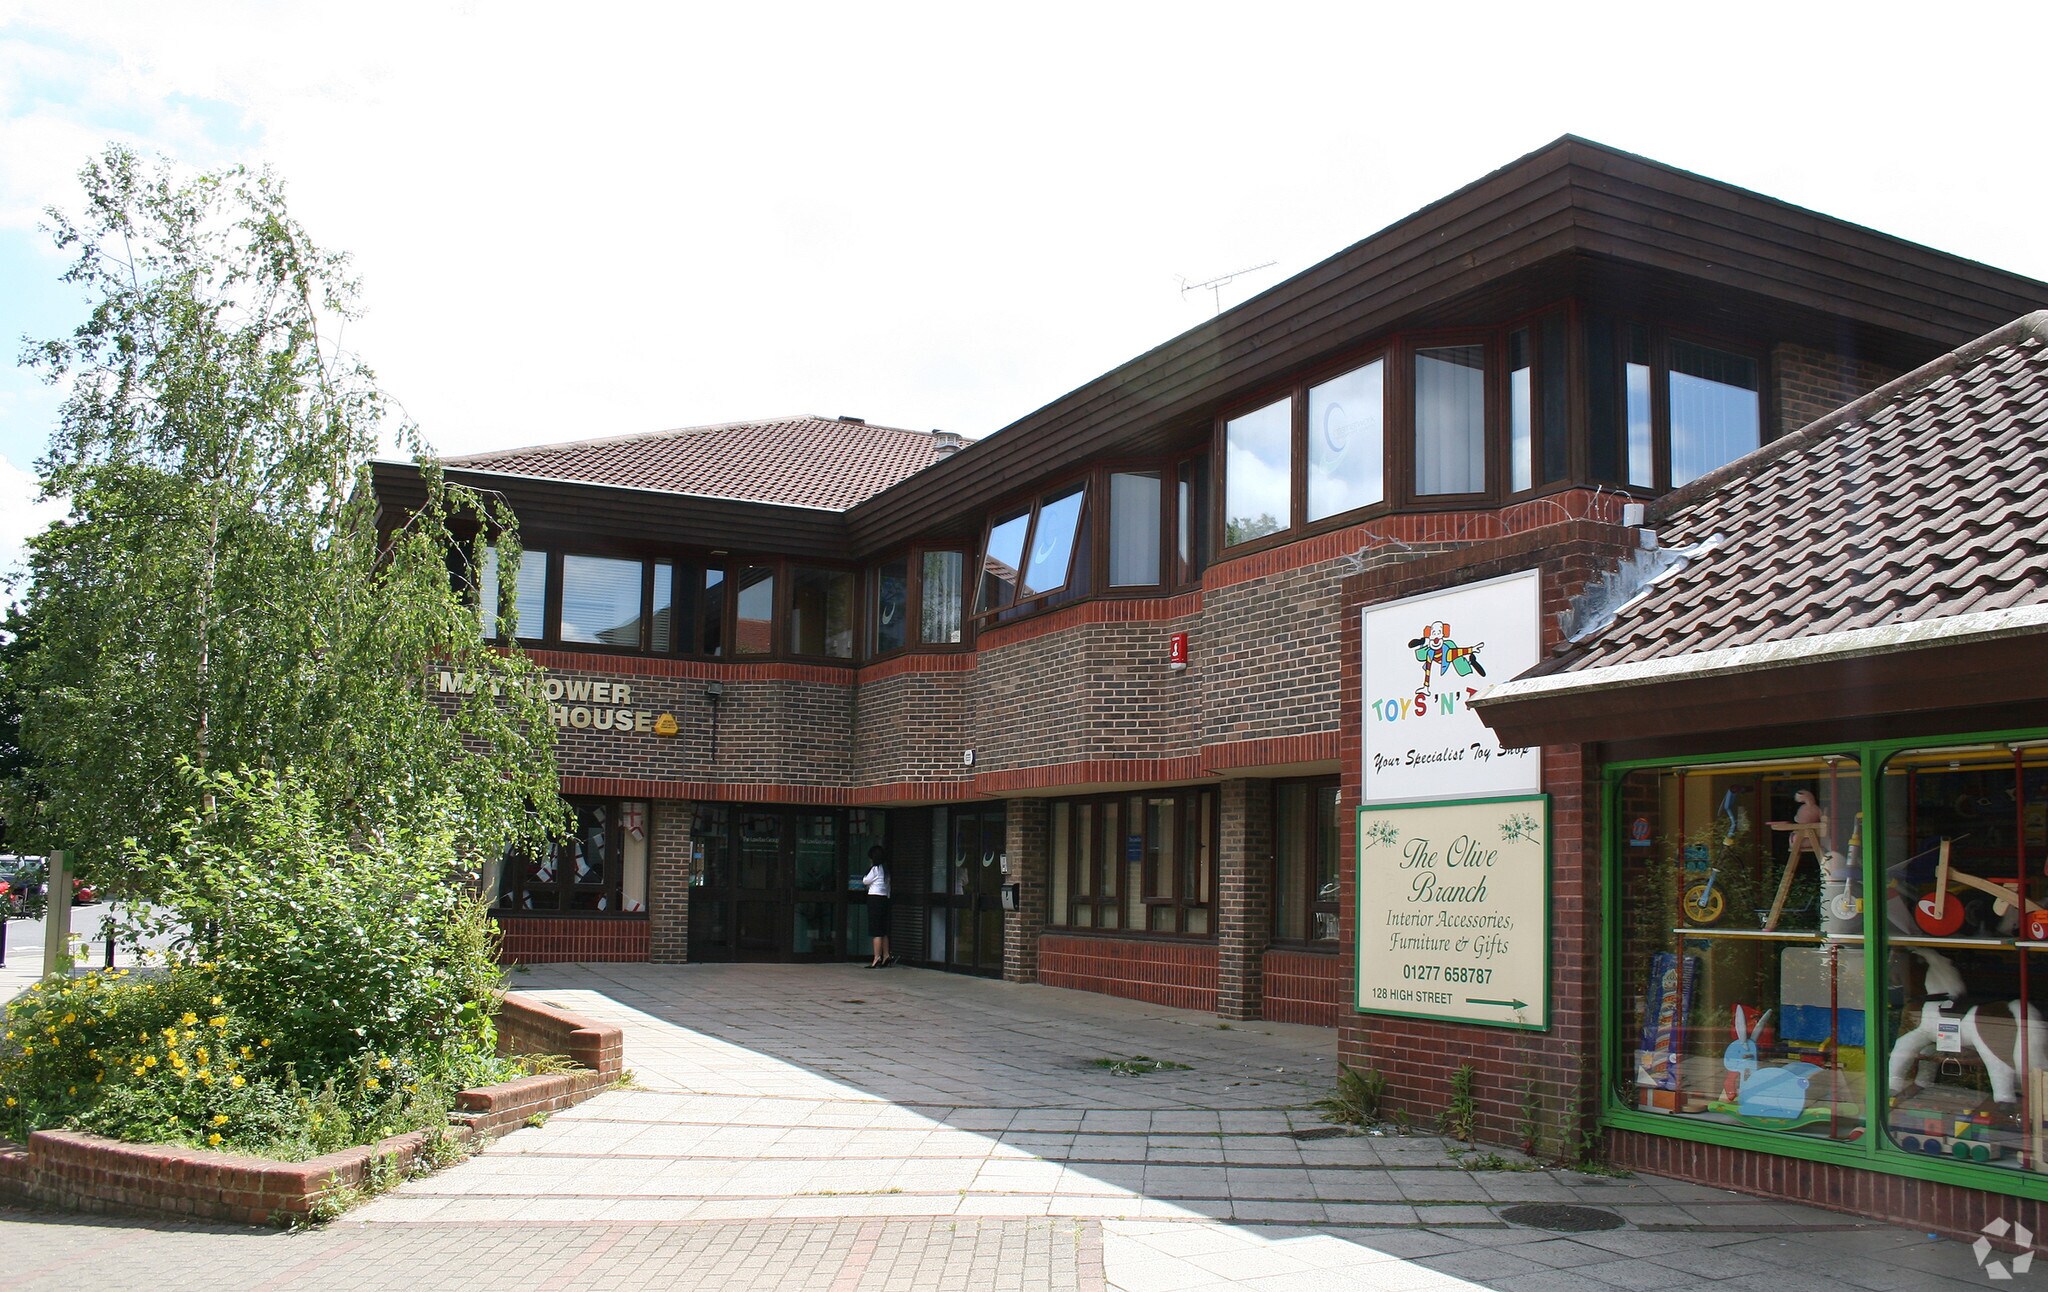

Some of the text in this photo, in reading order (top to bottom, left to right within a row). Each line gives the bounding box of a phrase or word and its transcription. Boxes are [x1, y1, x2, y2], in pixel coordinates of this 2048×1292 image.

[440, 671, 632, 706] MAYLOWER
[548, 706, 652, 732] HOUSE
[1374, 752, 1400, 774] Your
[1405, 748, 1465, 768] Specialist
[1470, 742, 1491, 762] Toy
[1399, 834, 1498, 870] The Olive
[1407, 870, 1489, 903] Branch
[1385, 909, 1514, 931] Interior Accessories,
[1389, 932, 1509, 959] Furniture & Gifts
[1403, 964, 1493, 984] 01277 658787
[1372, 987, 1453, 1004] 128 HIGH STREET
